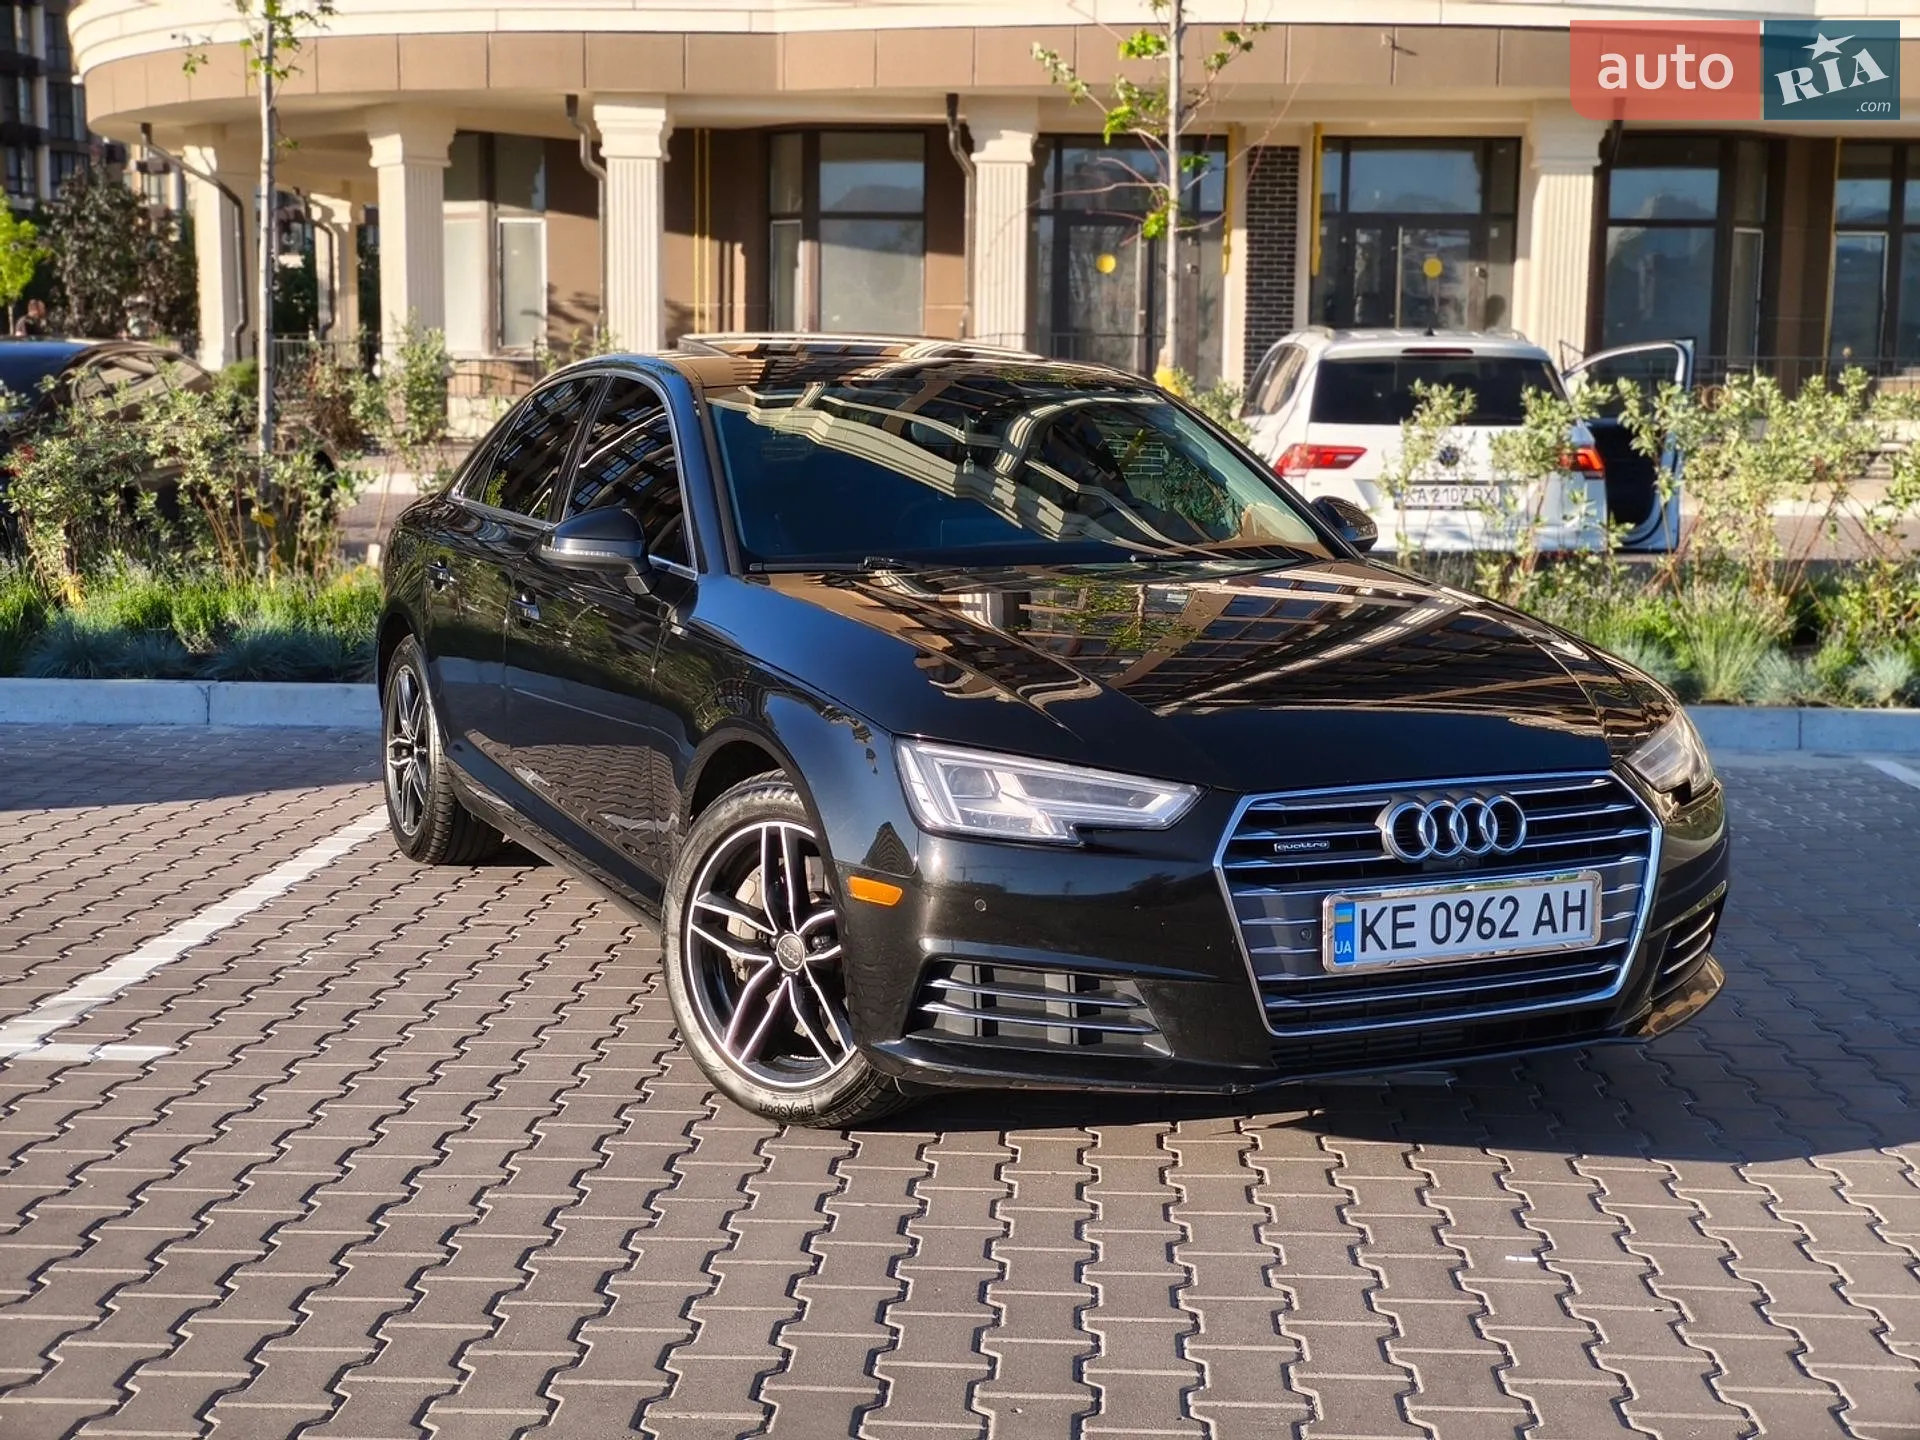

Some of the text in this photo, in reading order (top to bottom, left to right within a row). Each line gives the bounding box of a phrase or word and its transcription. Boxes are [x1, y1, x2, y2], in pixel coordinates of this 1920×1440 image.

[1277, 841, 1327, 852] quattro
[1360, 889, 1587, 952] KE 0962 AH
[1334, 940, 1352, 955] UA
